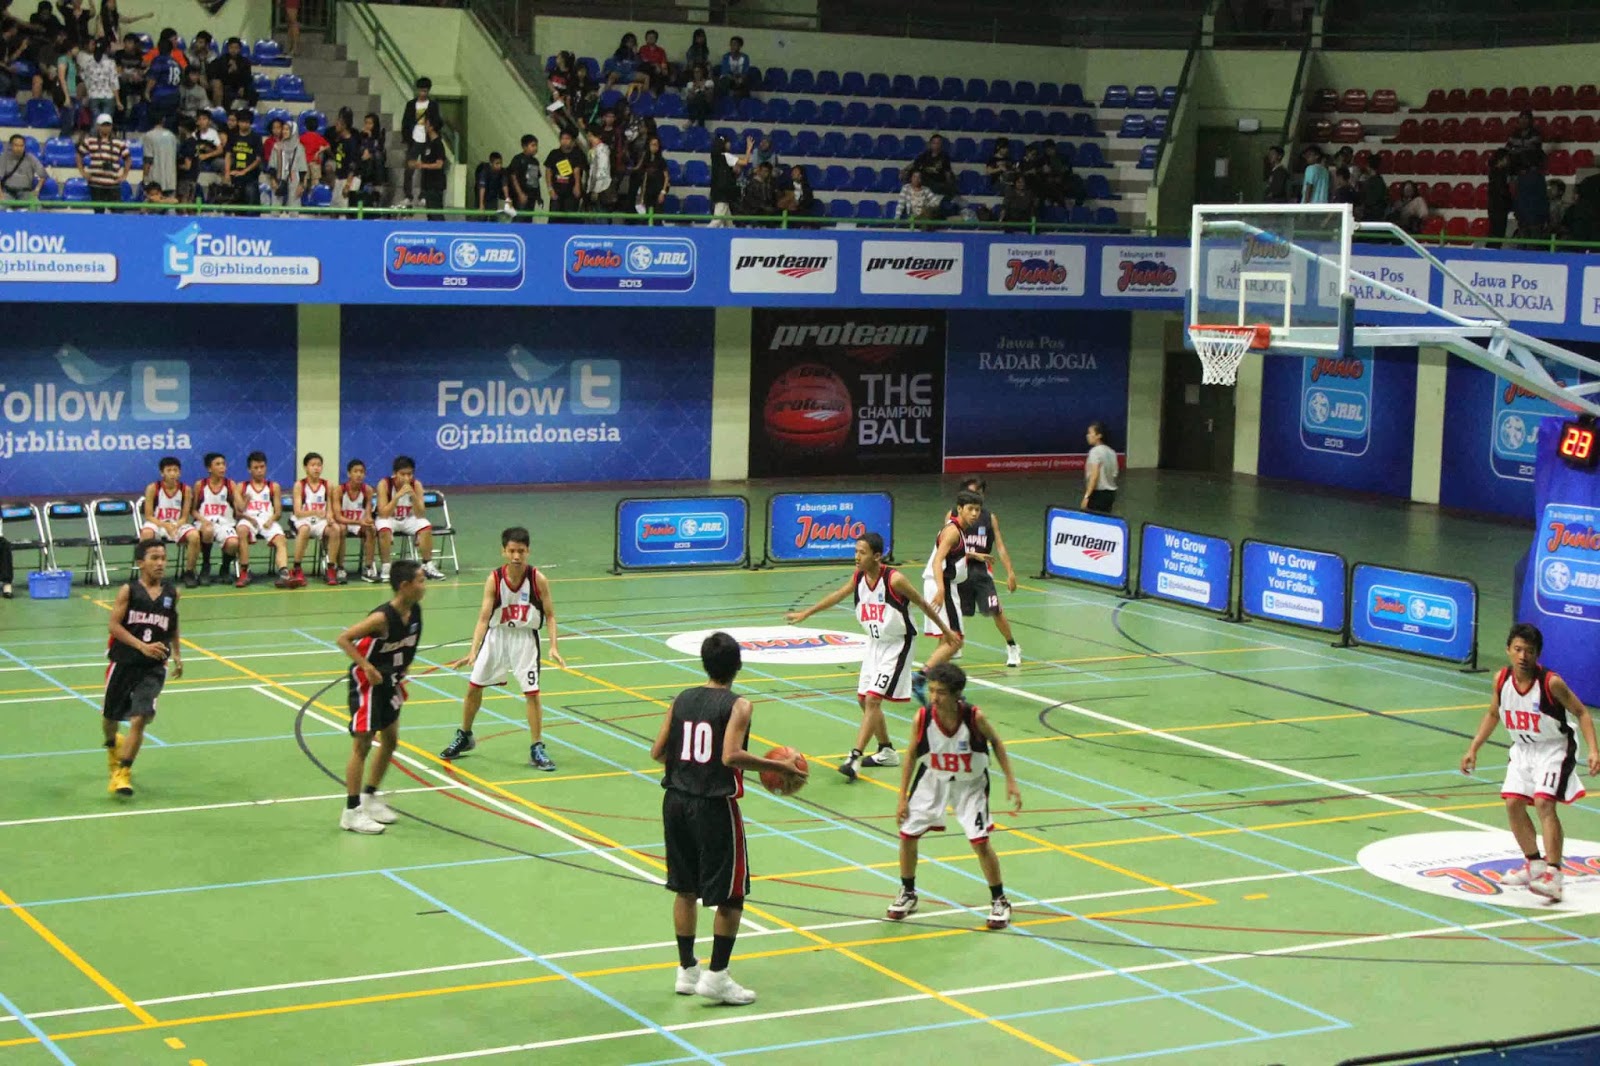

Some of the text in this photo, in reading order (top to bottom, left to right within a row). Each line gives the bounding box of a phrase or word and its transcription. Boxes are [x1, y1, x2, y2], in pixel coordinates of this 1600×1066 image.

[0, 230, 67, 253] ollow.
[196, 233, 273, 256] Follow.
[394, 246, 446, 270] Junio
[480, 249, 516, 263] JRBL
[573, 249, 622, 272] Junio
[654, 252, 688, 265] JRBL
[735, 254, 828, 270] proteam
[866, 256, 955, 272] proteam
[200, 262, 309, 277] @jrblindonesia
[1005, 258, 1067, 291] Junio
[1381, 267, 1404, 282] Pos
[442, 277, 468, 286] 2013
[619, 279, 642, 288] 2013
[1470, 272, 1537, 290] Jawa Pos
[1507, 292, 1554, 311] JOGJA
[769, 322, 929, 350] proteam
[997, 336, 1065, 349] Jawa Pos
[979, 351, 1098, 370] RADAR JOGJA
[437, 380, 564, 417] Follow
[859, 374, 932, 406] THE
[0, 383, 125, 423] ollow
[858, 406, 931, 419] CHAMPION
[1331, 402, 1363, 421] JRBL
[436, 422, 621, 450] @jrblindonesia
[858, 419, 931, 446] BALL
[1561, 428, 1593, 458] 23
[157, 508, 180, 520] ABY
[204, 504, 228, 517] ABY
[395, 506, 412, 517] BY
[796, 502, 853, 513] Tabungan BRI
[795, 515, 866, 549] Junio
[1054, 532, 1117, 553] proteam
[1165, 534, 1207, 554] We Grow
[1163, 558, 1178, 571] You
[1171, 550, 1198, 564] because
[1268, 550, 1317, 571] We Grow
[1268, 576, 1285, 589] You
[1276, 567, 1308, 581] because
[500, 604, 531, 624] ABY
[861, 603, 886, 623] ABY
[869, 623, 880, 639] 13
[527, 671, 536, 685] 9
[874, 672, 890, 689] 13
[1504, 710, 1542, 734] ABY
[680, 721, 713, 763] 10
[930, 753, 973, 773] ABY
[1542, 772, 1557, 788] 11
[974, 812, 984, 831] 4
